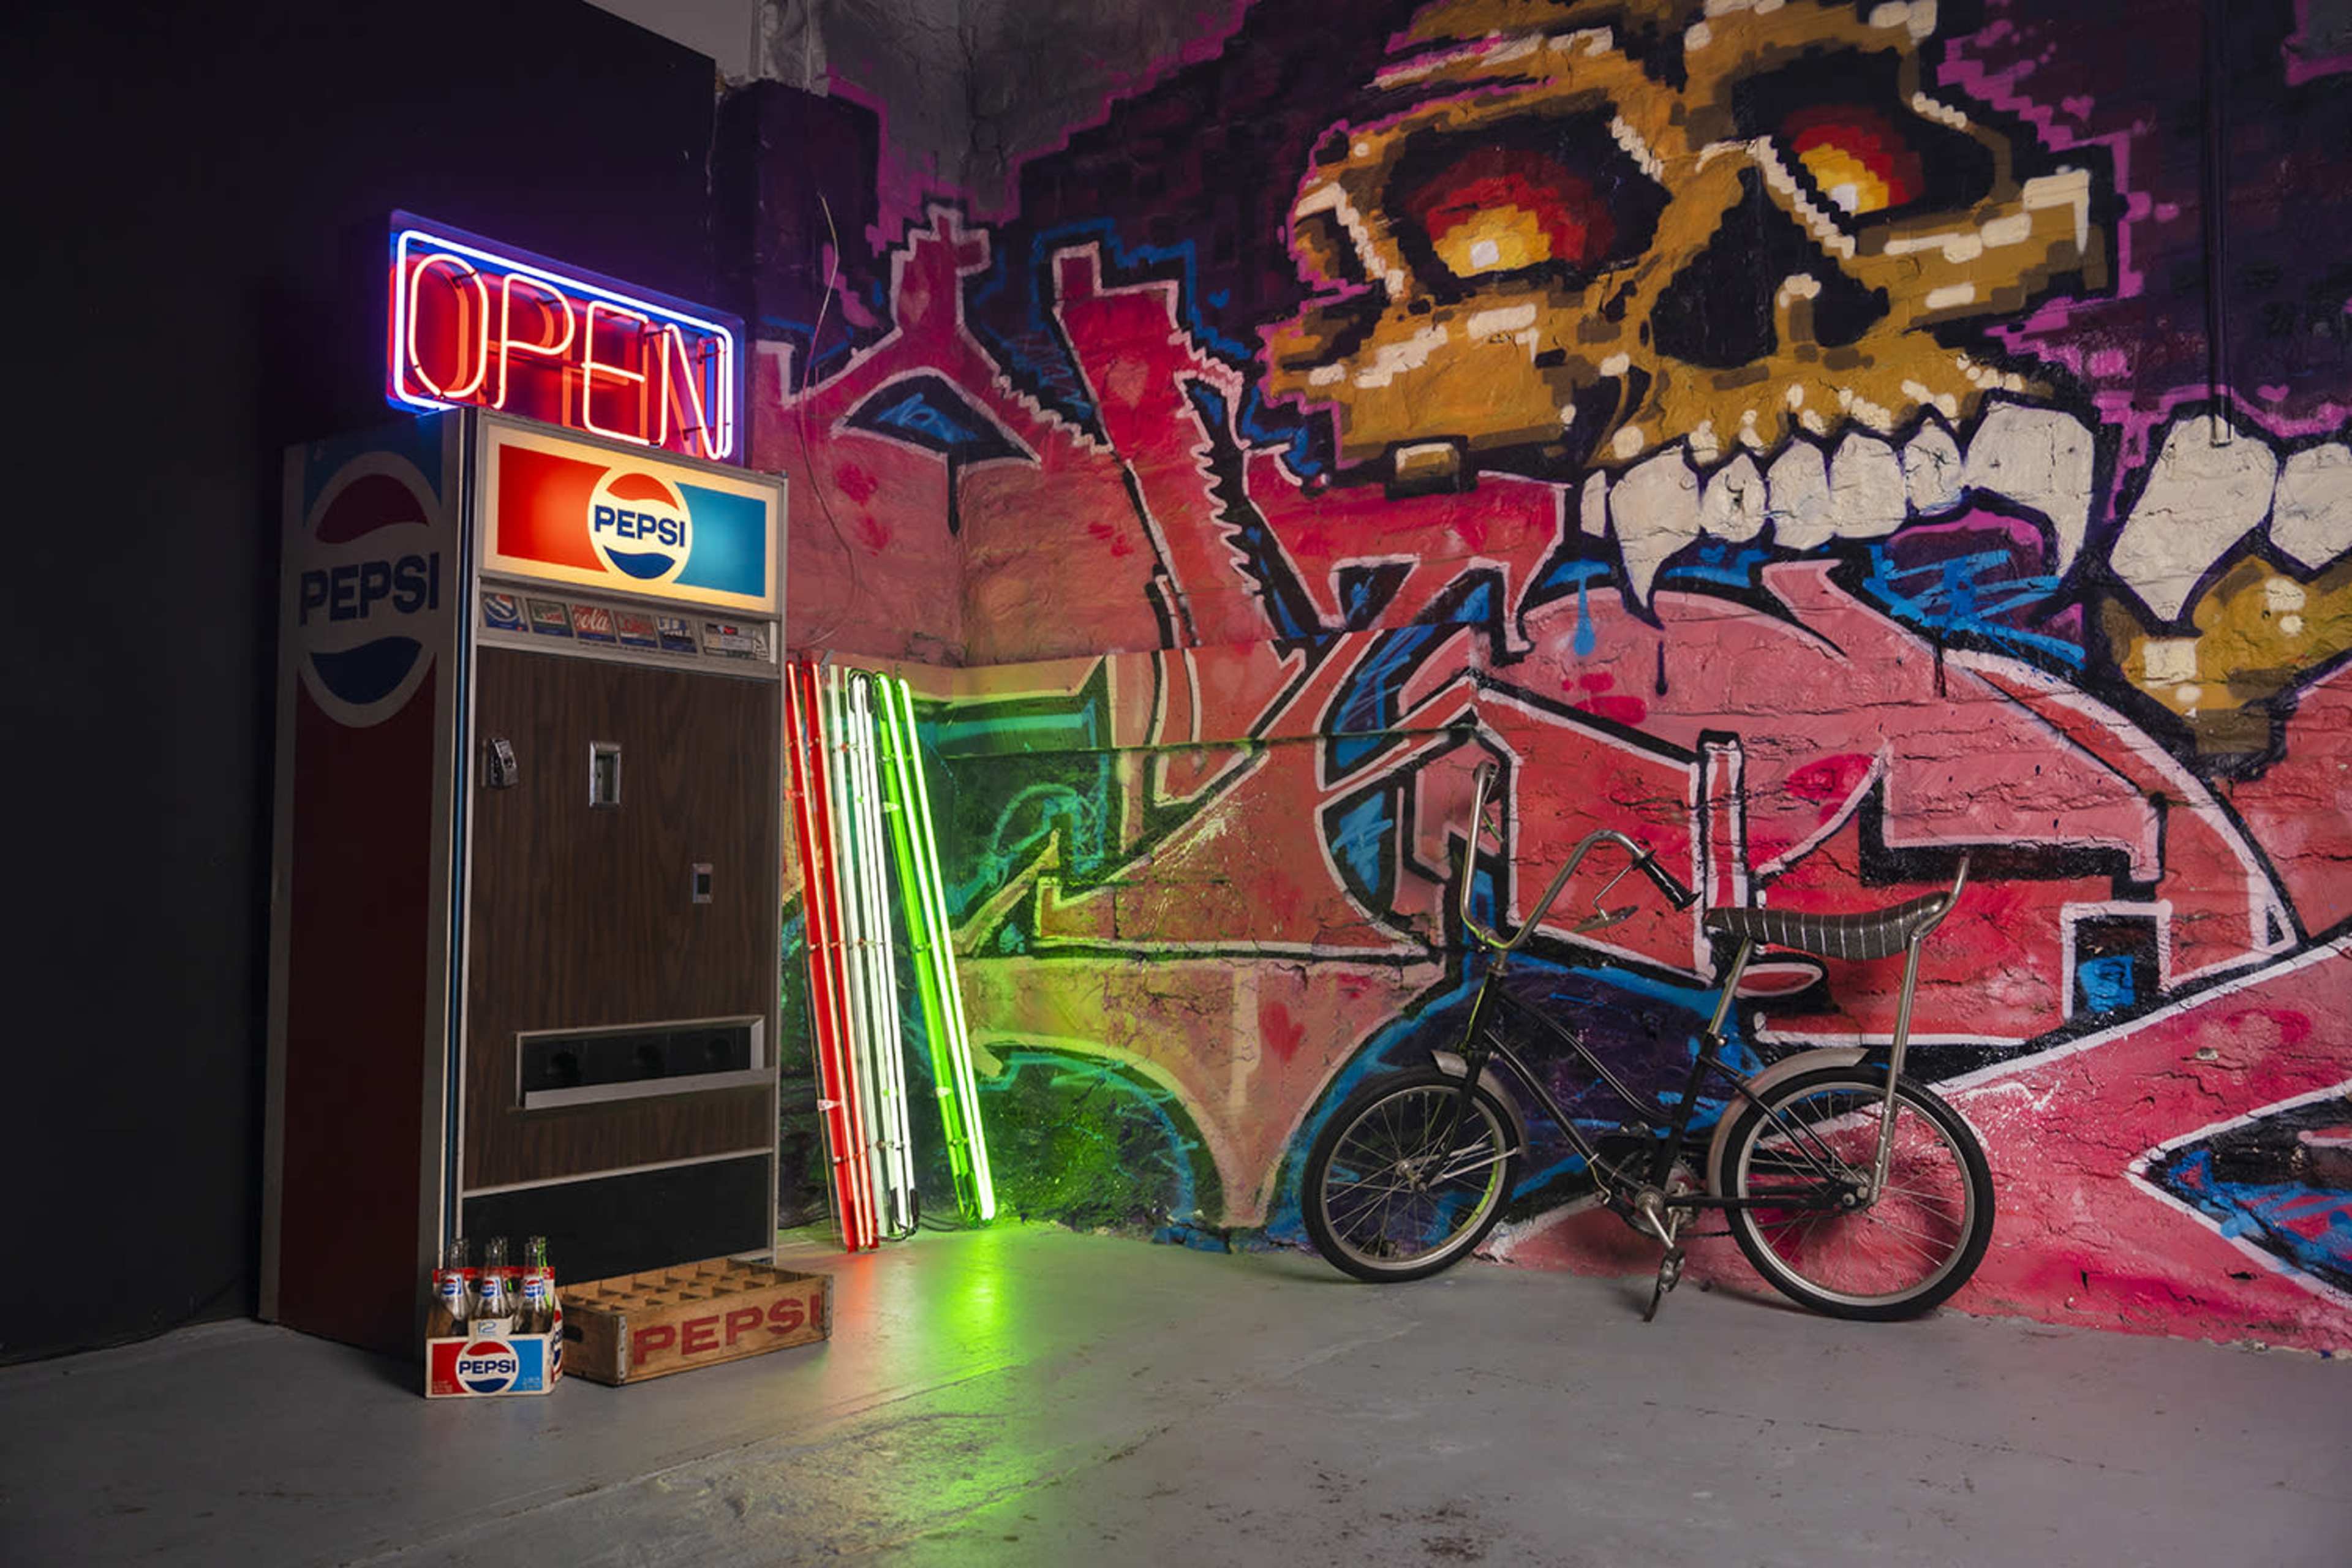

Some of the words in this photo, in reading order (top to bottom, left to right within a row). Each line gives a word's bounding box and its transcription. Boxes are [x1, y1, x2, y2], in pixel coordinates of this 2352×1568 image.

[409, 253, 725, 460] OPEN
[595, 505, 685, 547] PEPSI
[300, 552, 439, 626] PEPSI
[633, 1292, 821, 1365] PEPSI
[459, 1359, 516, 1374] PEPSI
